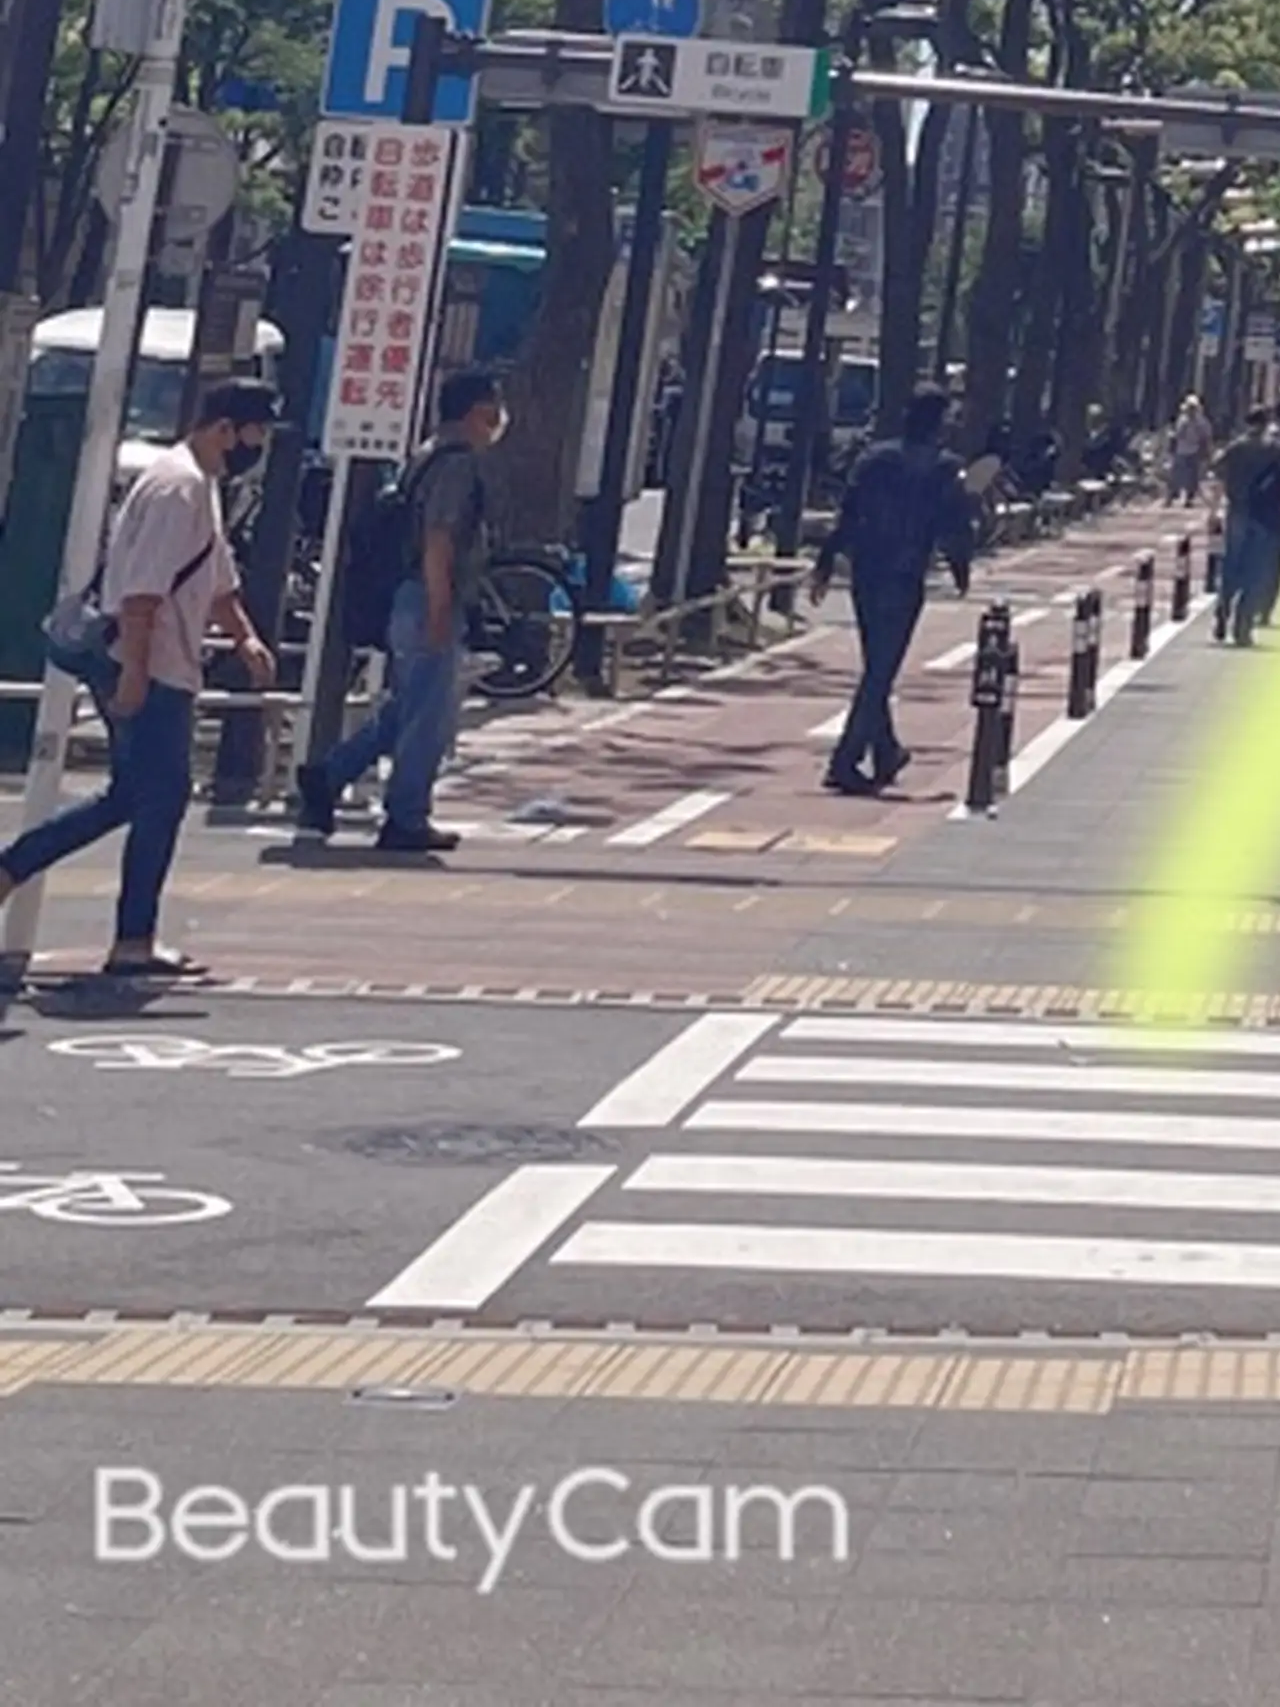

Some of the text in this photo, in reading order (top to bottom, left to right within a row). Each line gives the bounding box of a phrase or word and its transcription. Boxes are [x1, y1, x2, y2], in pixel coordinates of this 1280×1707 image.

[339, 137, 405, 406] 自転車は徐行運転
[375, 137, 442, 411] 歩道は歩行者優先
